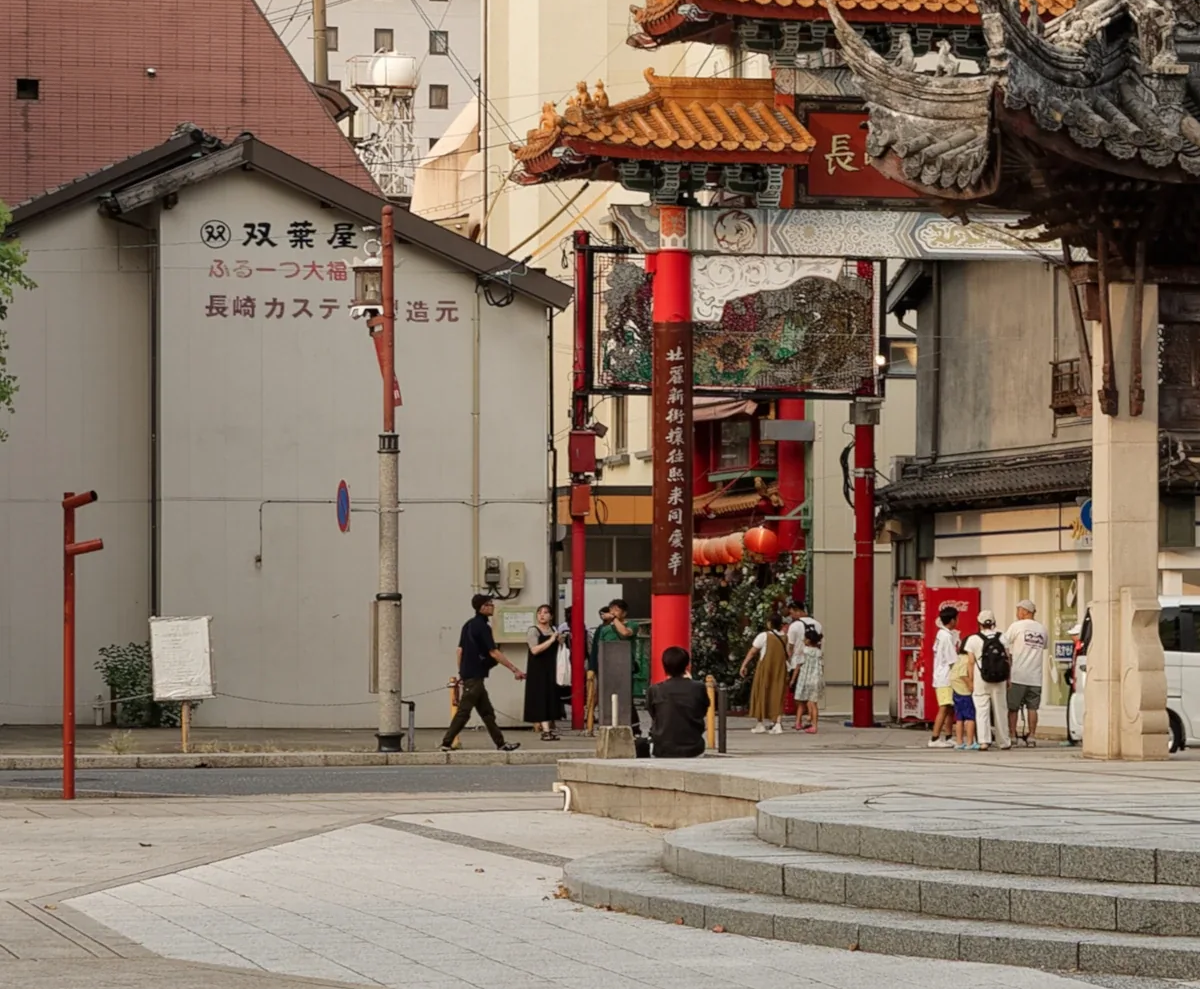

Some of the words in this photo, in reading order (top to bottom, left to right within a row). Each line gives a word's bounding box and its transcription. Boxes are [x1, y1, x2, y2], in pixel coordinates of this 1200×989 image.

[824, 134, 872, 175] 長
[242, 220, 358, 250] 双葉屋
[208, 258, 348, 281] ふるーつ大福
[205, 295, 460, 323] 長崎カステ造元
